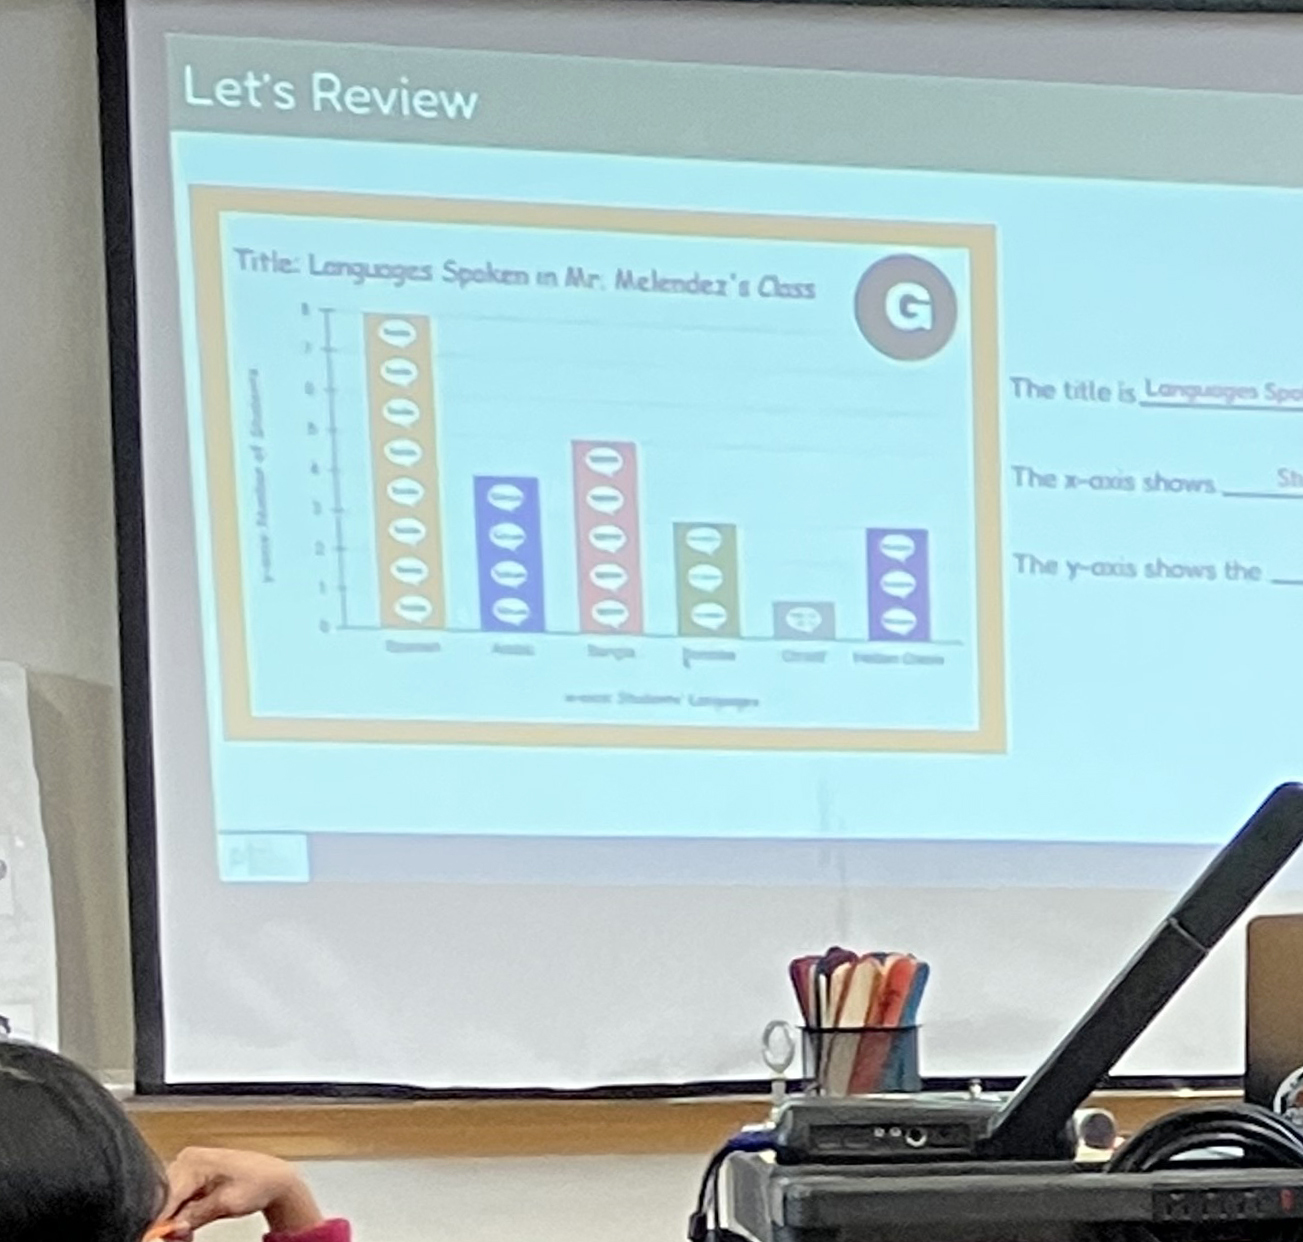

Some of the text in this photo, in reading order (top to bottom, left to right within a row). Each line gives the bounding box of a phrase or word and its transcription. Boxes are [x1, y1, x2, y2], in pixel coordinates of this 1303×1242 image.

[184, 64, 479, 121] Let's Review
[232, 247, 817, 300] Title: Languages Spoken in Mr. Melendez's Class
[885, 281, 934, 333] G
[1009, 375, 1058, 401] The
[1063, 379, 1112, 403] title
[1116, 379, 1138, 404] is
[1144, 376, 1260, 405] Languages
[1010, 464, 1058, 489] The
[1063, 468, 1137, 492] x-axis
[1142, 469, 1217, 495] shows
[1012, 551, 1263, 582] The y-axis shows the
